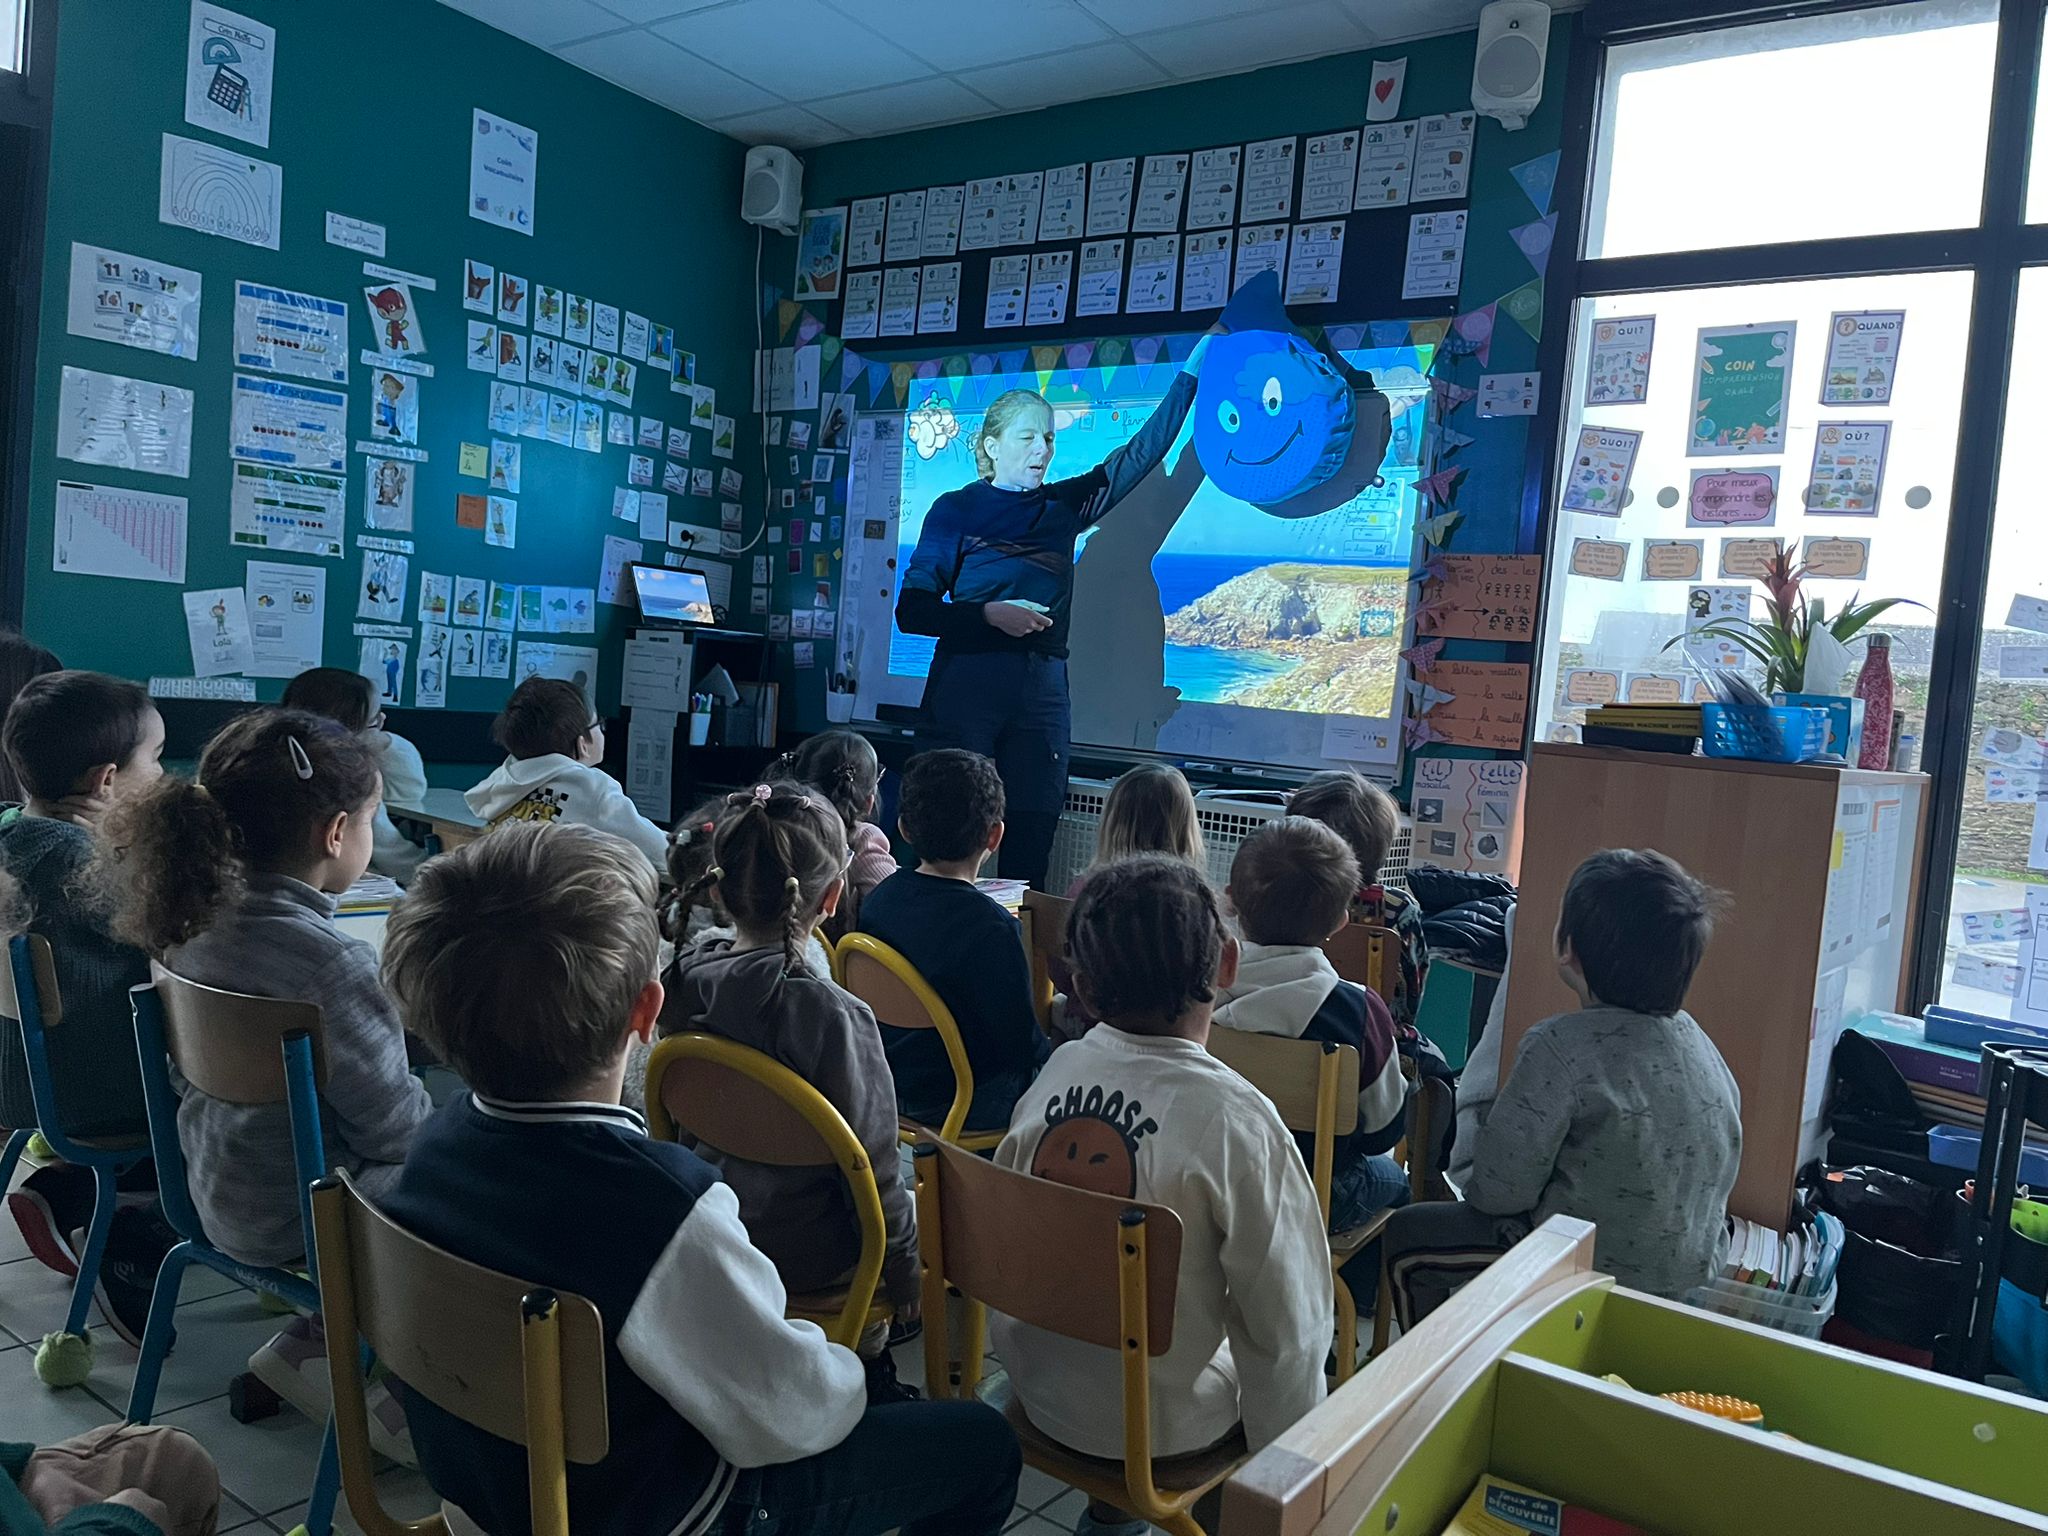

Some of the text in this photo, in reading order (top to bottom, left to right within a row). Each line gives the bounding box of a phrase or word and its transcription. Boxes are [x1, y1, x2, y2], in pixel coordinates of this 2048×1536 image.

[1618, 326, 1644, 336] QUI?
[1857, 321, 1900, 331] QUAND?
[1725, 360, 1755, 371] COIN
[1600, 438, 1633, 448] QUOI?
[1706, 478, 1758, 488] Pour mieux
[1696, 492, 1767, 504] comprendre les
[1702, 508, 1740, 518] histoires
[1431, 761, 1516, 777] il elle
[1045, 1085, 1158, 1154] CHOOSE
[1532, 1500, 1548, 1511] de
